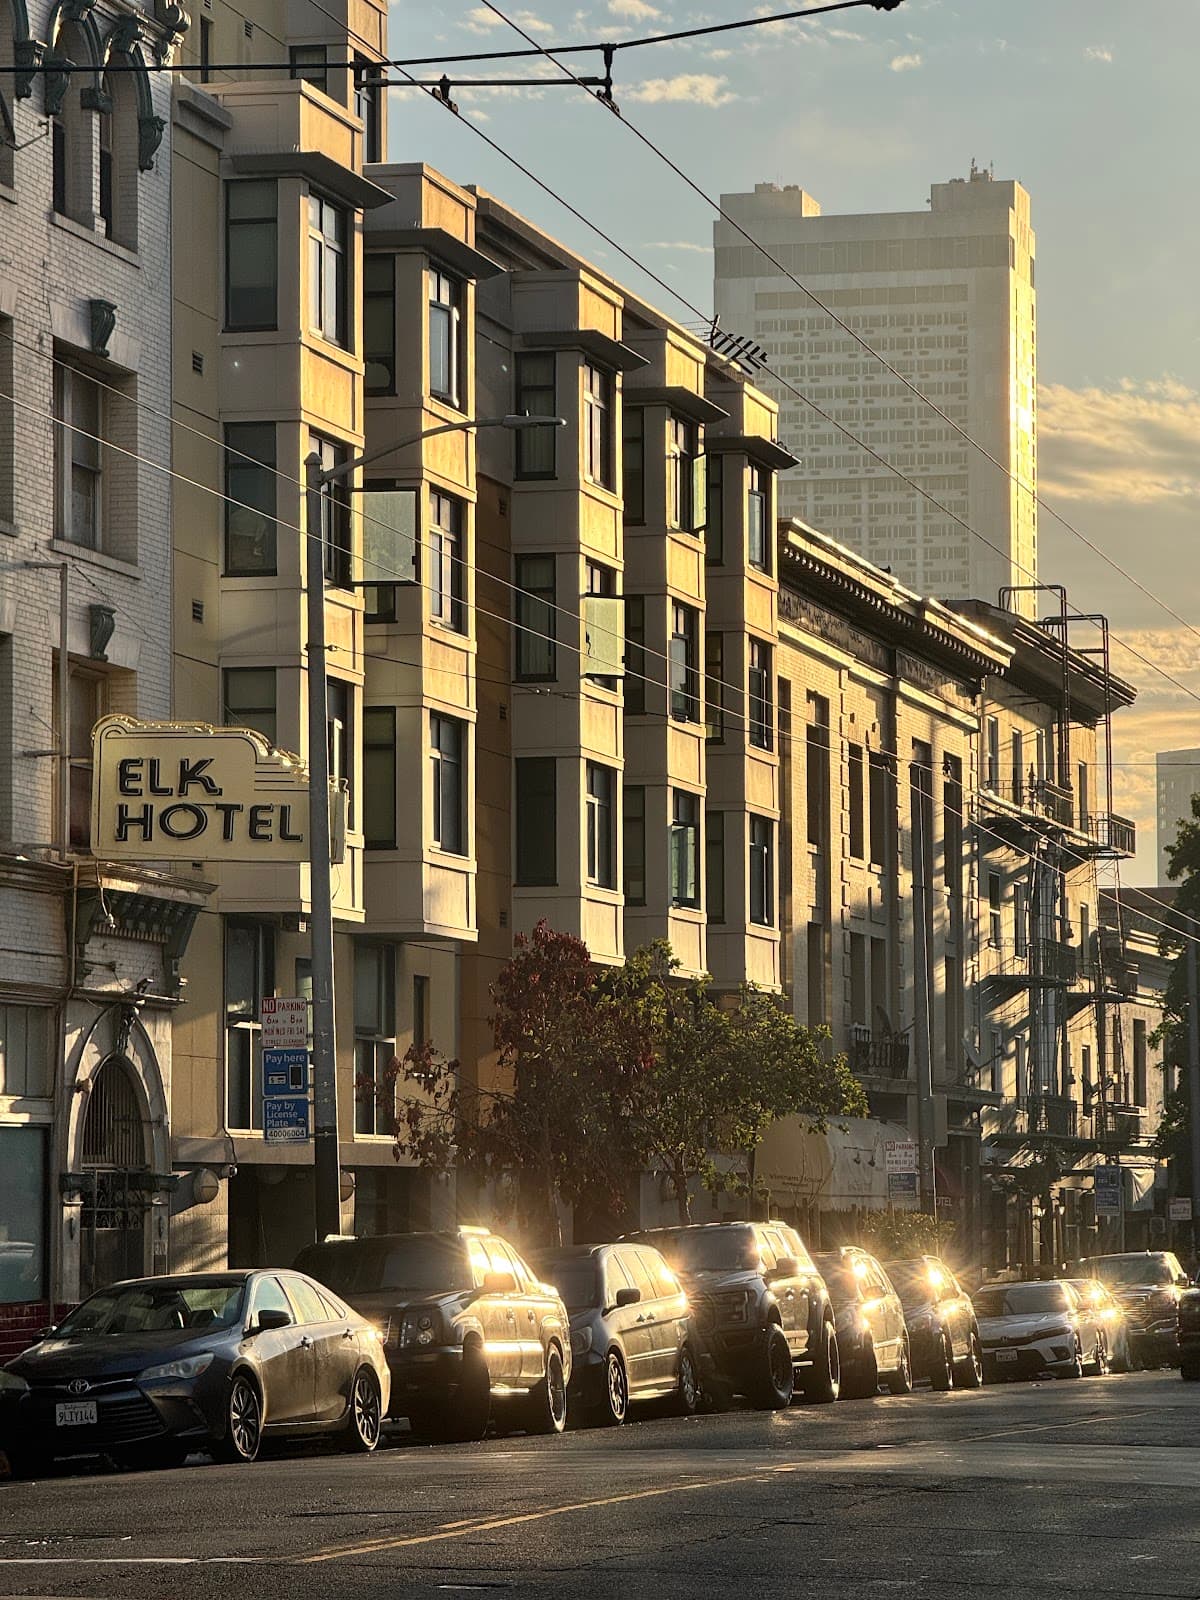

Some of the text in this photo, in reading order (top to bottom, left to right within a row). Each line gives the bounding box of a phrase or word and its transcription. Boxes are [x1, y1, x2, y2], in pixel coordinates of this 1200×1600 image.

[118, 758, 222, 796] ELK
[115, 803, 303, 842] HOTEL
[263, 1000, 305, 1012] NO PARKING
[265, 1053, 304, 1064] Pay here
[266, 1102, 295, 1112] Pay by
[266, 1111, 298, 1119] License
[266, 1119, 288, 1127] Plate
